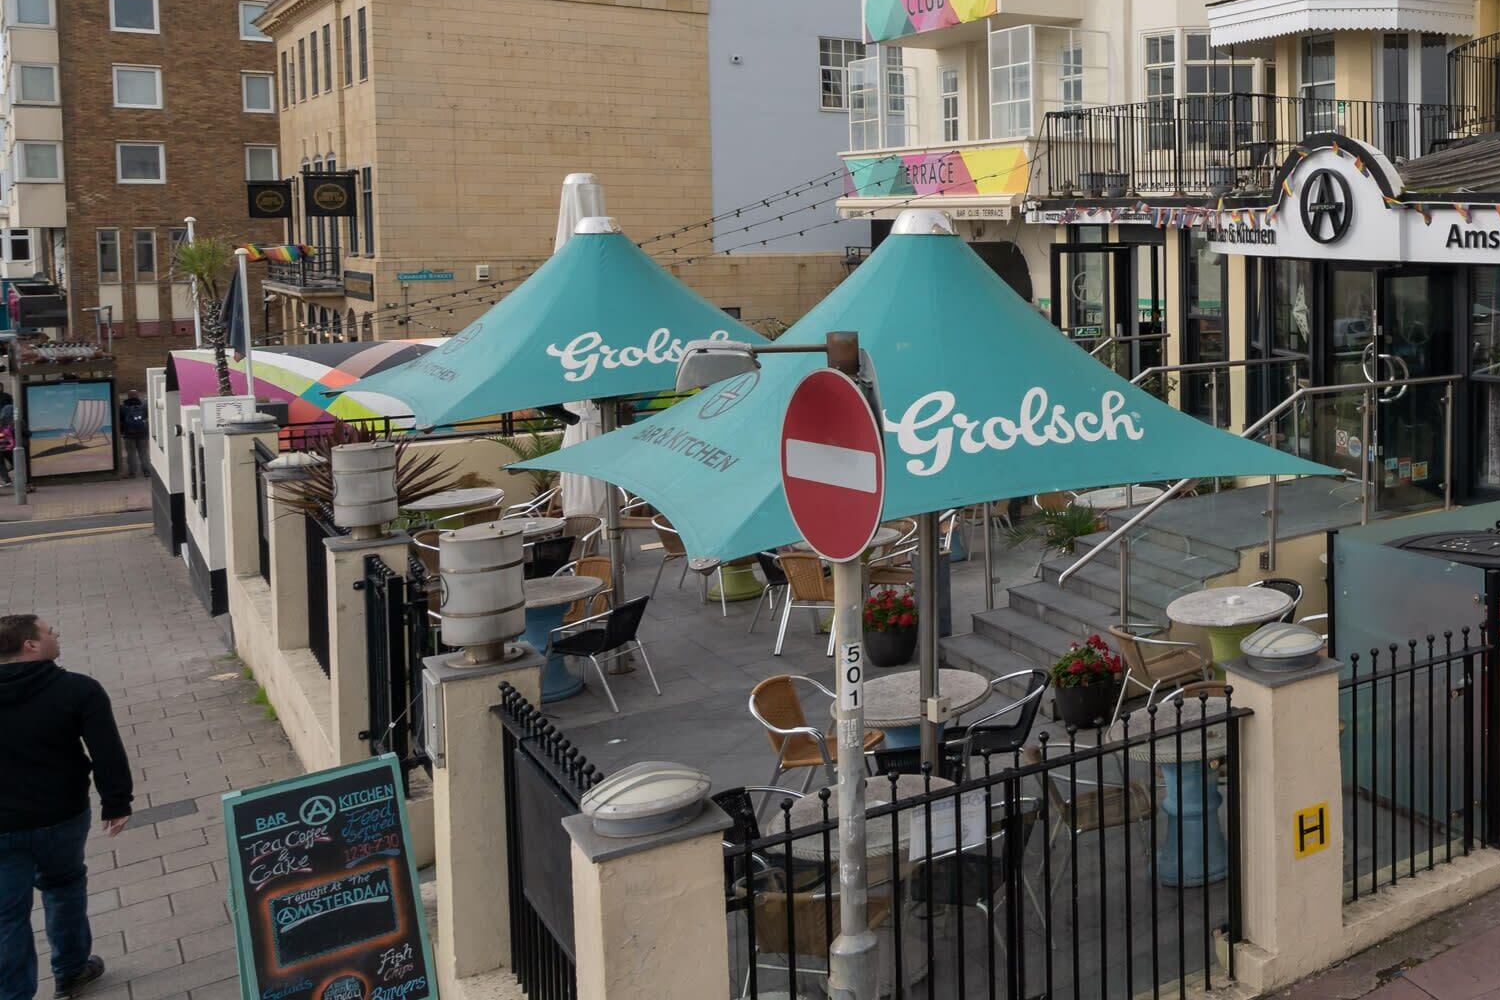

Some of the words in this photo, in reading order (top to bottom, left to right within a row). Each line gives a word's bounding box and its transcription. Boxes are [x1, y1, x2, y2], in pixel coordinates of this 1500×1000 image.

[898, 162, 954, 186] TERRACE
[982, 209, 1004, 217] TERRACE
[1237, 223, 1276, 245] Kitchen
[547, 327, 730, 382] Grols
[881, 386, 1144, 477] Grolsch
[665, 428, 740, 473] KITCHEN
[255, 811, 289, 831] BAR
[338, 783, 395, 809] KITCHEN
[344, 800, 393, 825] Food
[245, 838, 282, 858] Tea
[285, 825, 329, 850] Coffee
[1298, 807, 1325, 853] H
[249, 854, 310, 885] Cake
[277, 880, 389, 925] AMSTERDAM
[282, 886, 328, 905] Tonight
[330, 882, 343, 893] At
[348, 874, 371, 887] The
[377, 943, 413, 975] Fish
[371, 975, 426, 1000] Burgers
